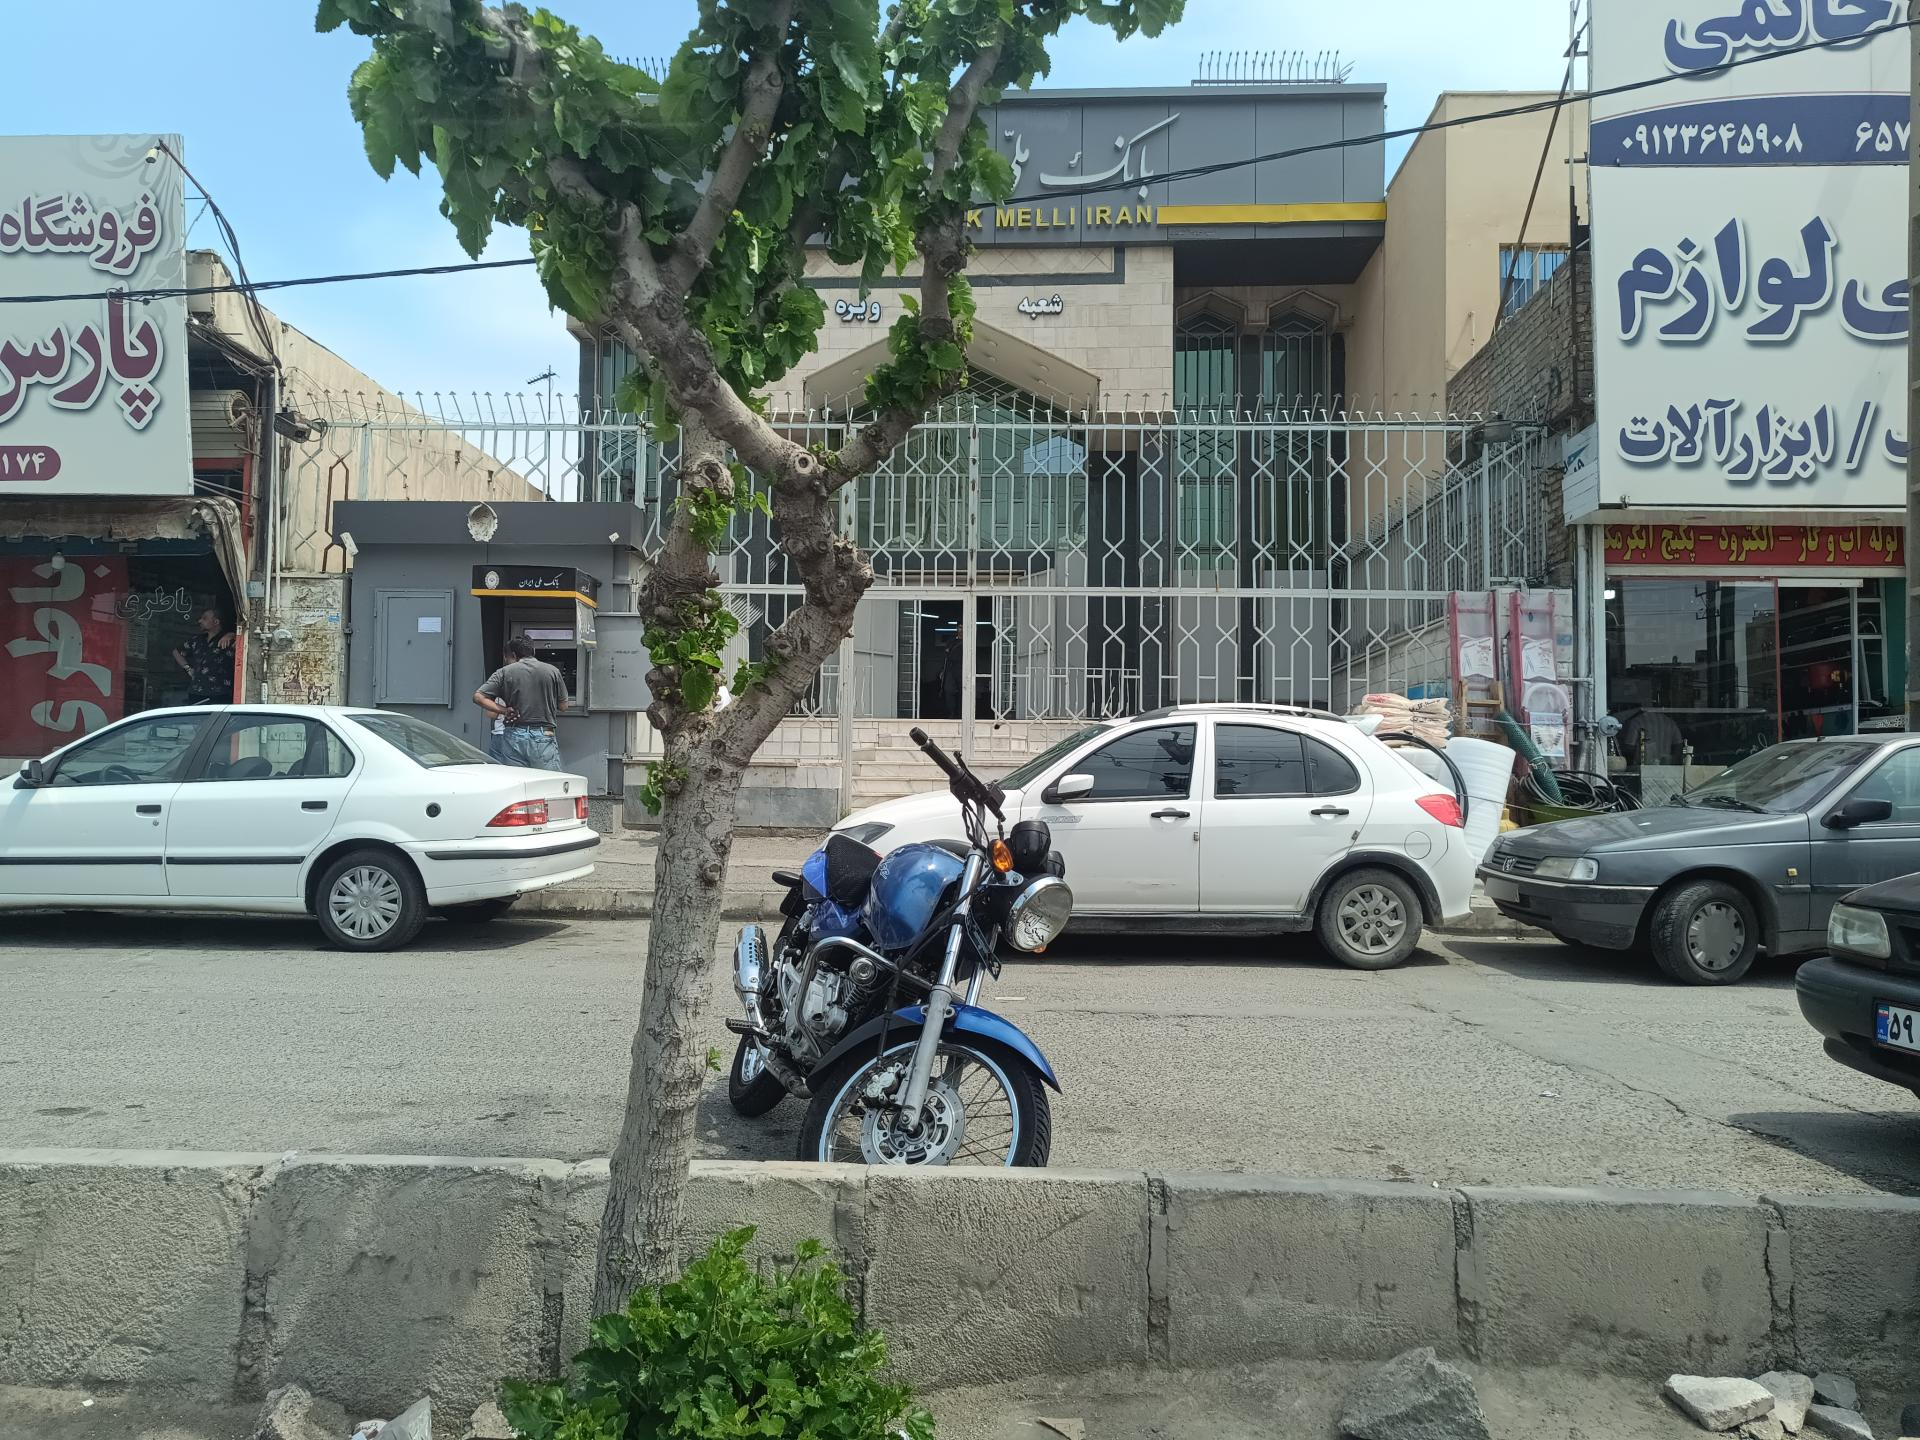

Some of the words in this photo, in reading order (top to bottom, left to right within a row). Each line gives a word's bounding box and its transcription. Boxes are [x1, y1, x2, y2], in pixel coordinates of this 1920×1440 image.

[1622, 122, 1803, 155] ۰۹۱۲۳۶۴۵۹۰۸
[0, 193, 157, 269] فروشگاه
[996, 206, 1075, 228] MELLI
[1087, 204, 1153, 226] IRAN
[1617, 215, 1832, 335] لوازم
[1018, 294, 1063, 320] شعبه
[0, 287, 158, 424] پارس
[114, 585, 192, 620] باطری
